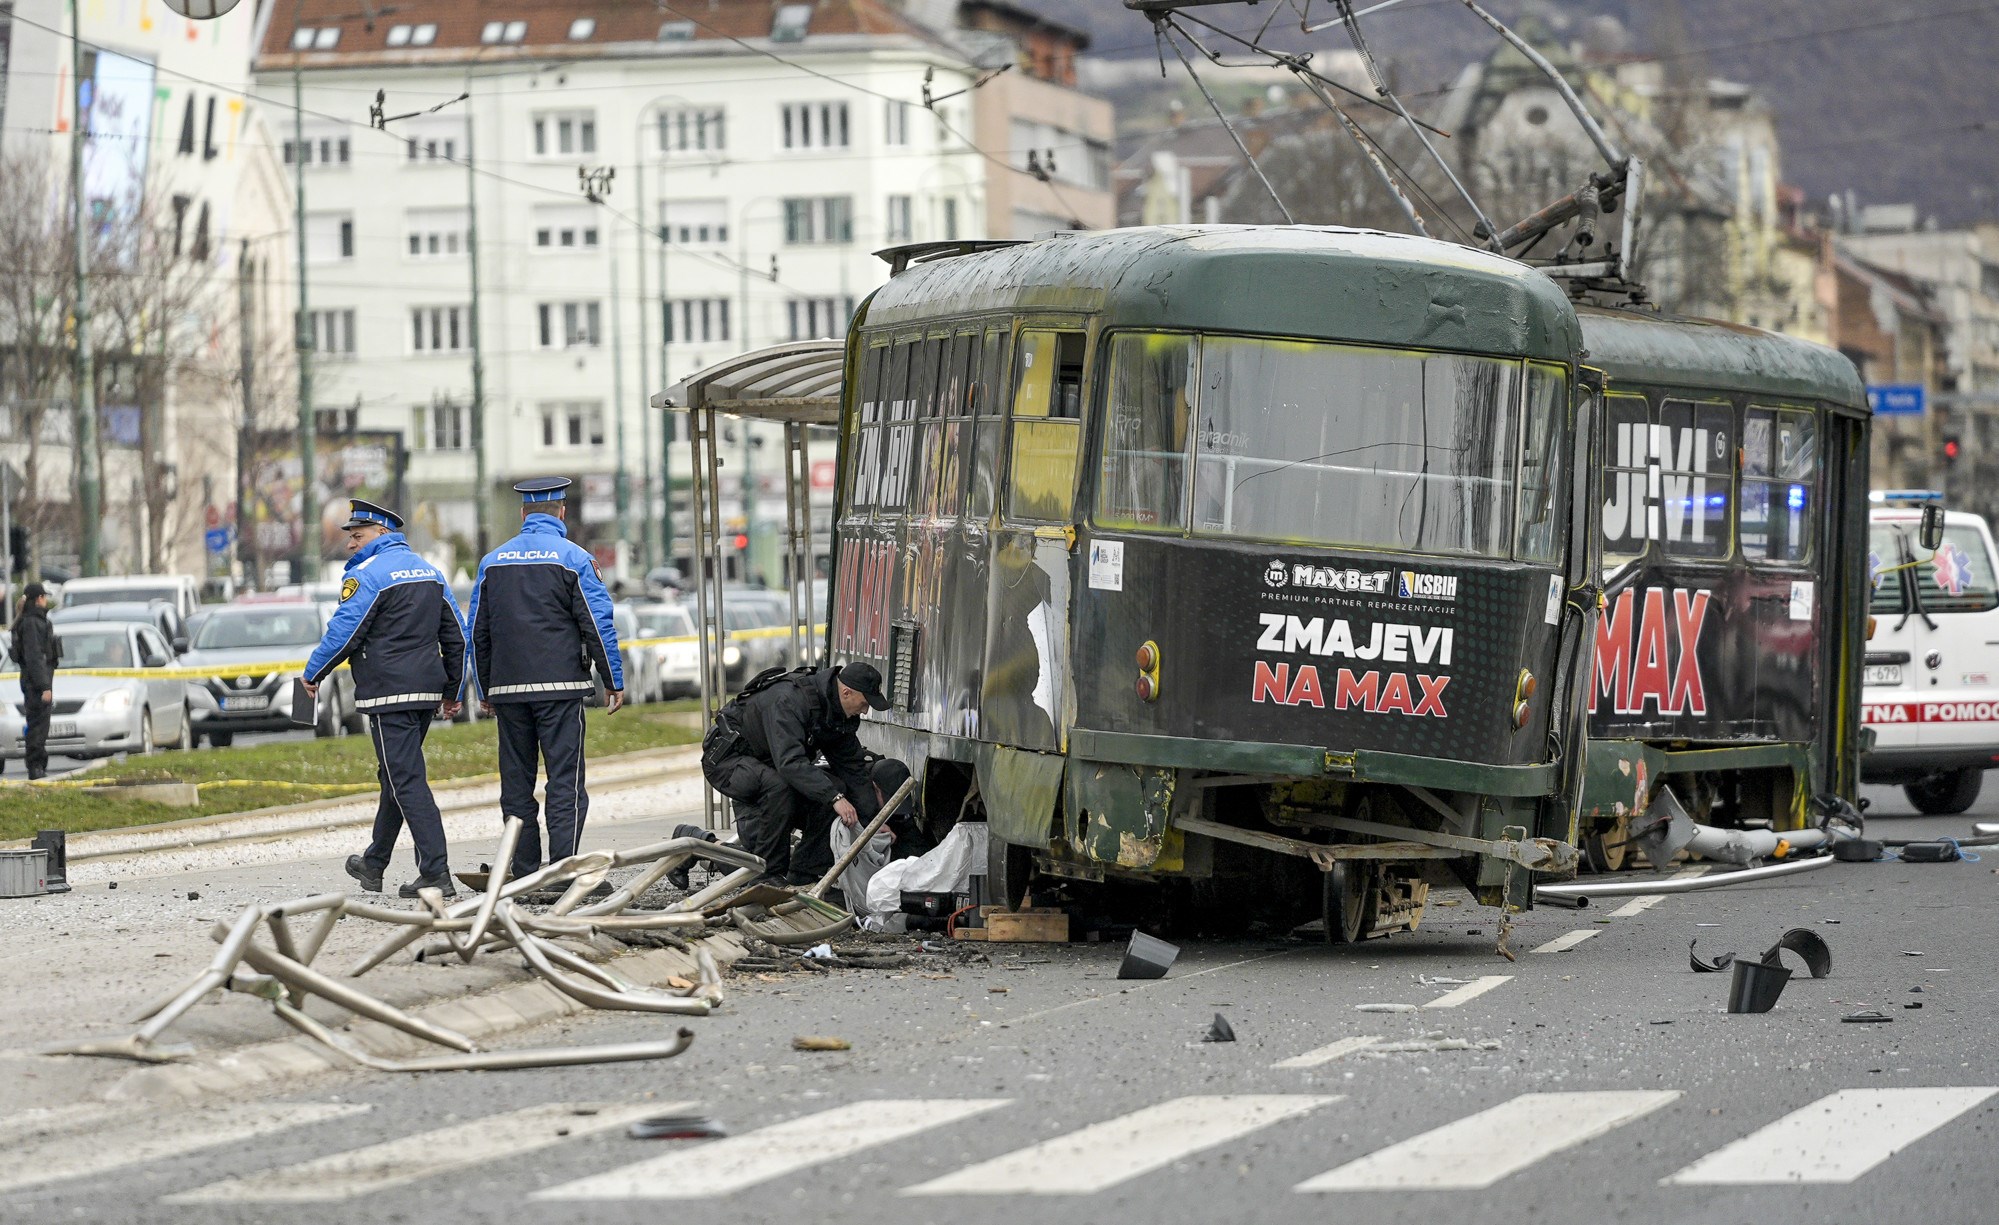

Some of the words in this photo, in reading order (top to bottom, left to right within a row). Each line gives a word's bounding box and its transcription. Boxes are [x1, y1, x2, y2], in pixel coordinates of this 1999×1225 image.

[497, 550, 559, 561] POLICIJA
[389, 569, 437, 580] POLICIJA
[1413, 573, 1458, 596] KSBIH
[1261, 592, 1309, 603] PREMIUM
[1314, 597, 1362, 607] PARTNER
[1367, 601, 1456, 614] REPREZENTACIJE
[1256, 612, 1454, 665] ZMAJEVI
[1587, 587, 1711, 716] MAX
[1252, 660, 1325, 709] NA
[1334, 667, 1451, 718] MAX
